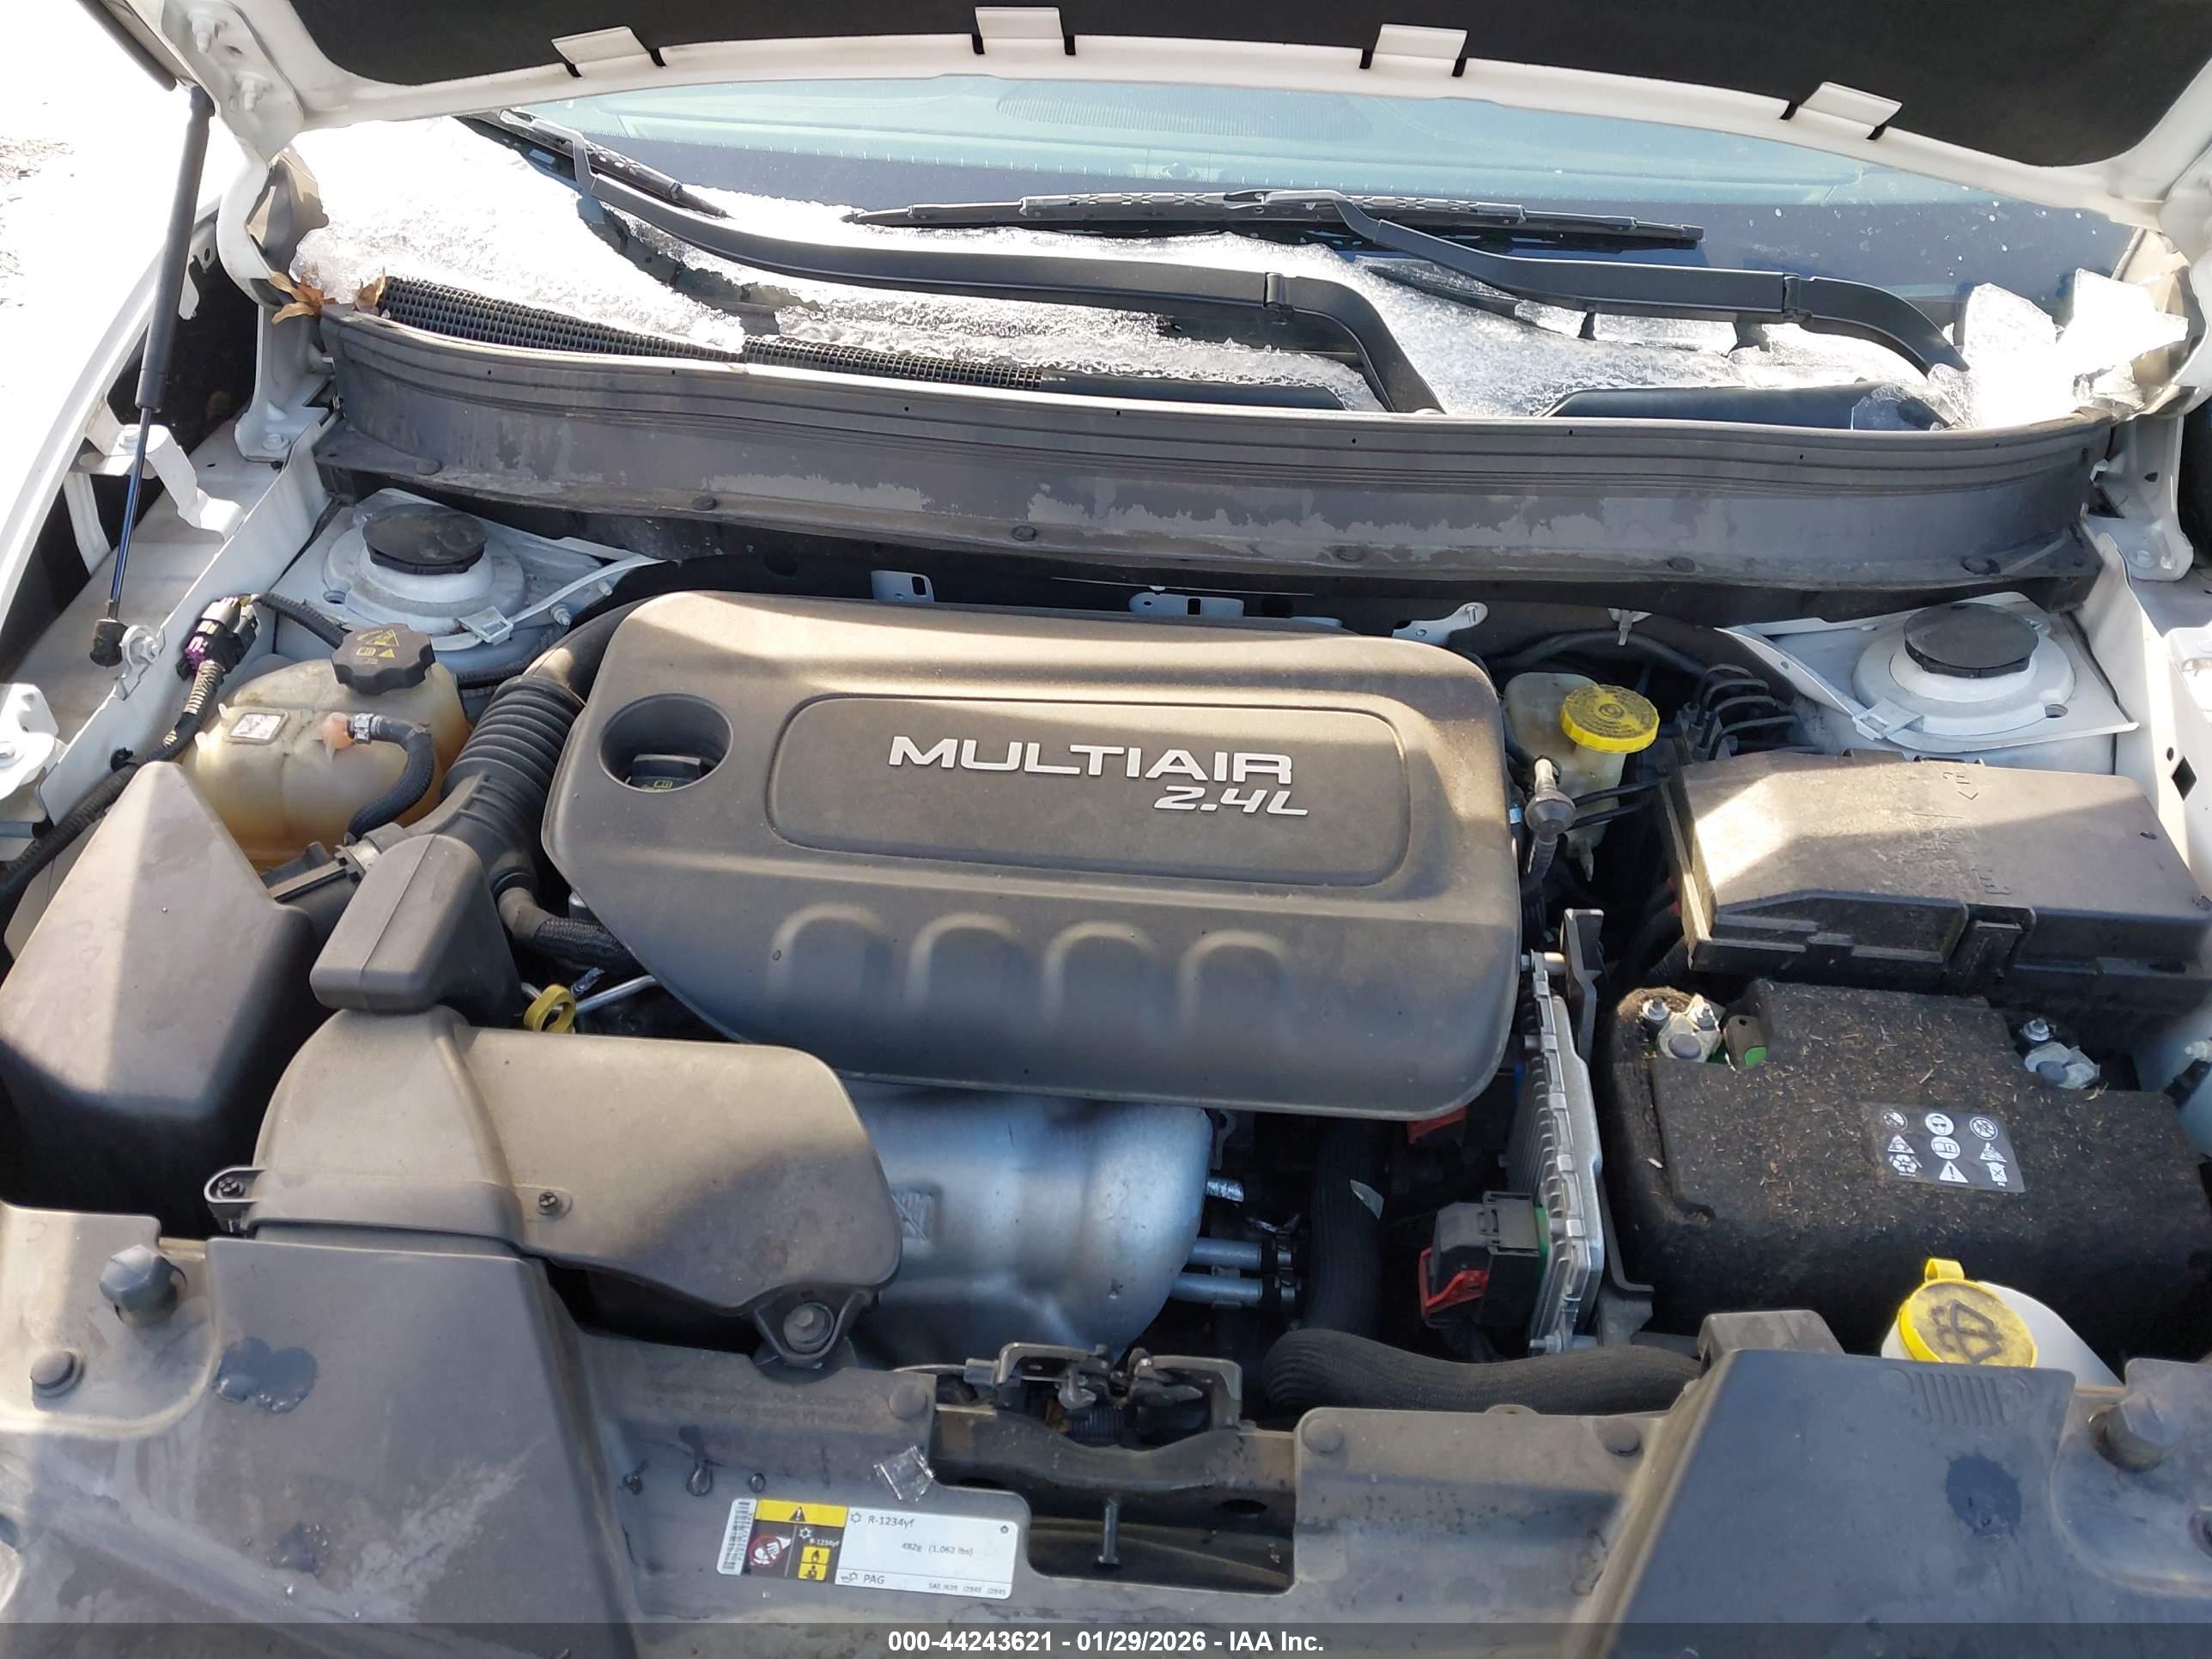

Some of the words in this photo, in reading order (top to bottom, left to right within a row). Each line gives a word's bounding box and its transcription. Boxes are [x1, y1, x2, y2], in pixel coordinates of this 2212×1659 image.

[888, 736, 1293, 785] MULTIAIR
[1154, 785, 1309, 817] 2.4L
[868, 1515, 915, 1529] R-1234yf
[928, 1545, 956, 1555] (1.062
[957, 1547, 975, 1557] lbs)
[863, 1573, 885, 1585] PAG
[928, 1582, 941, 1590] SAE
